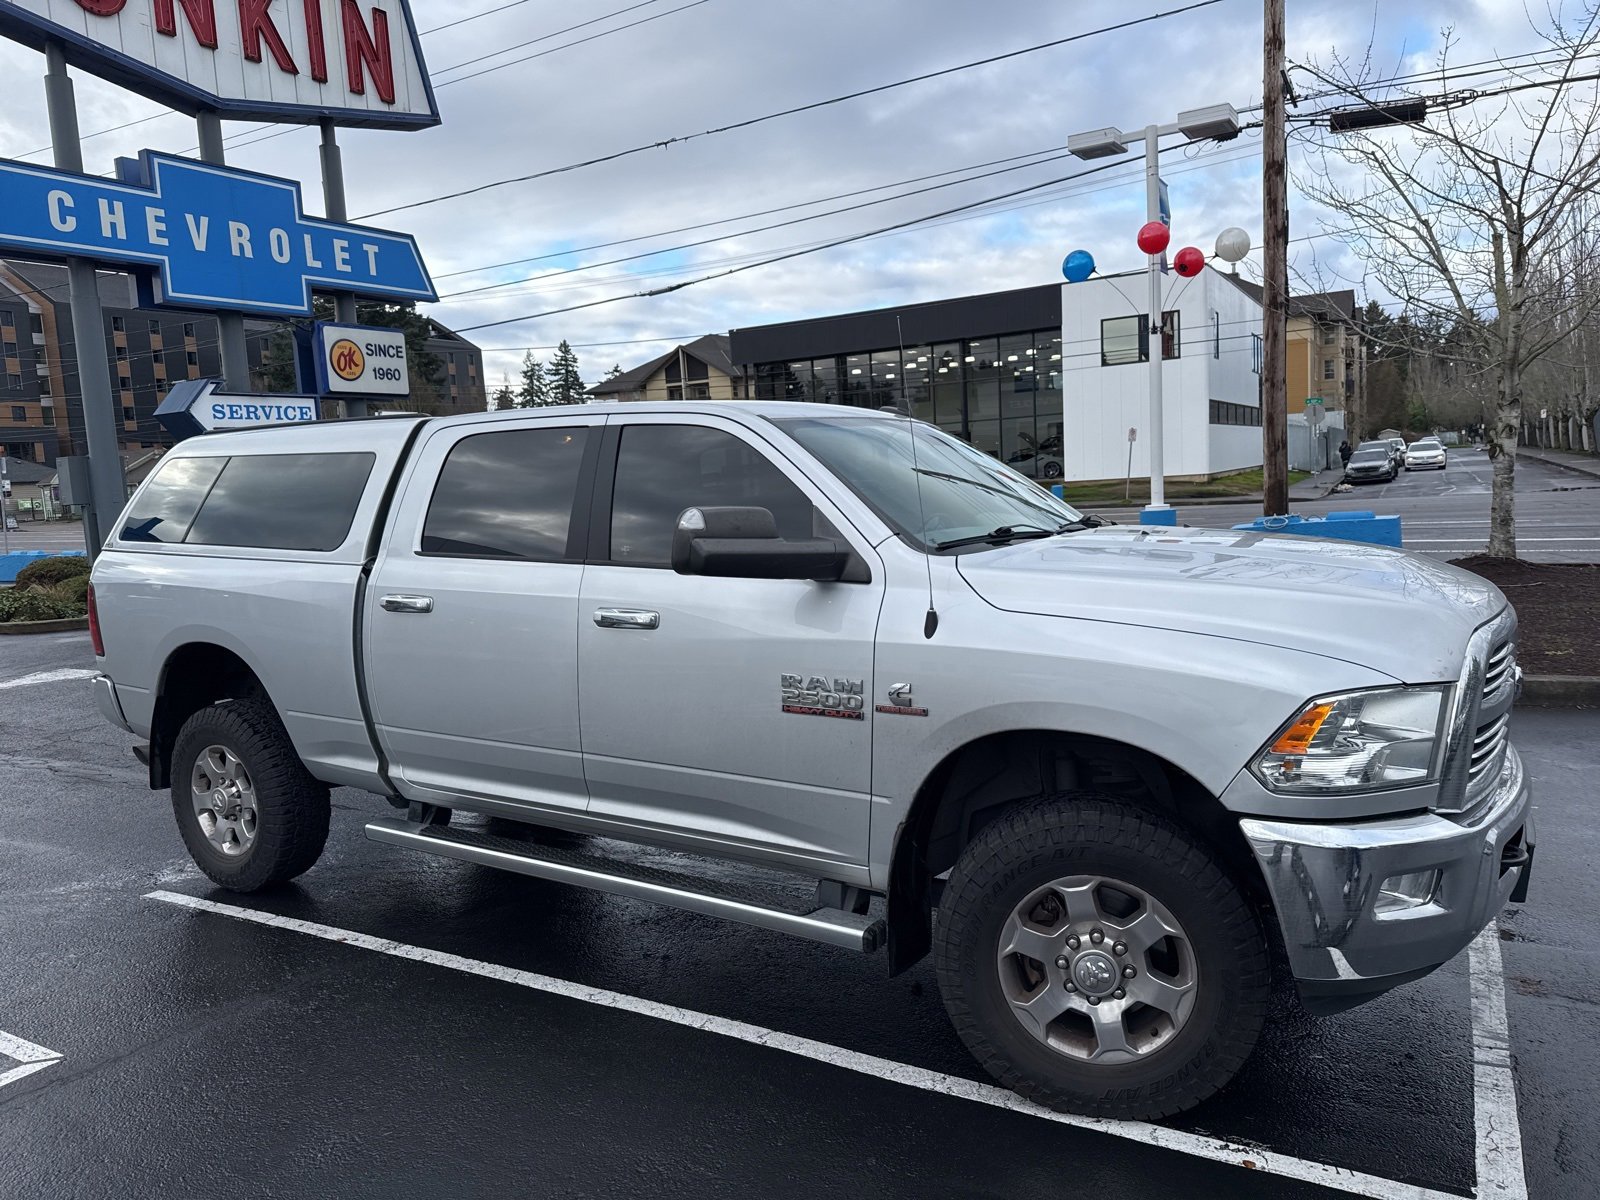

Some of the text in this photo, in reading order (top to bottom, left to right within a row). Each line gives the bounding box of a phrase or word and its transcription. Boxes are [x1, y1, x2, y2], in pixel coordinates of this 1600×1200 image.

[75, 0, 396, 104] KIN
[47, 189, 379, 276] CHEVROLET
[337, 346, 360, 372] OK
[365, 343, 404, 359] SINCE
[373, 367, 401, 381] 1960
[211, 403, 313, 420] SERVICE
[781, 672, 864, 694] RAM
[782, 689, 864, 710] 2500
[783, 705, 859, 718] HEAVY DUTY
